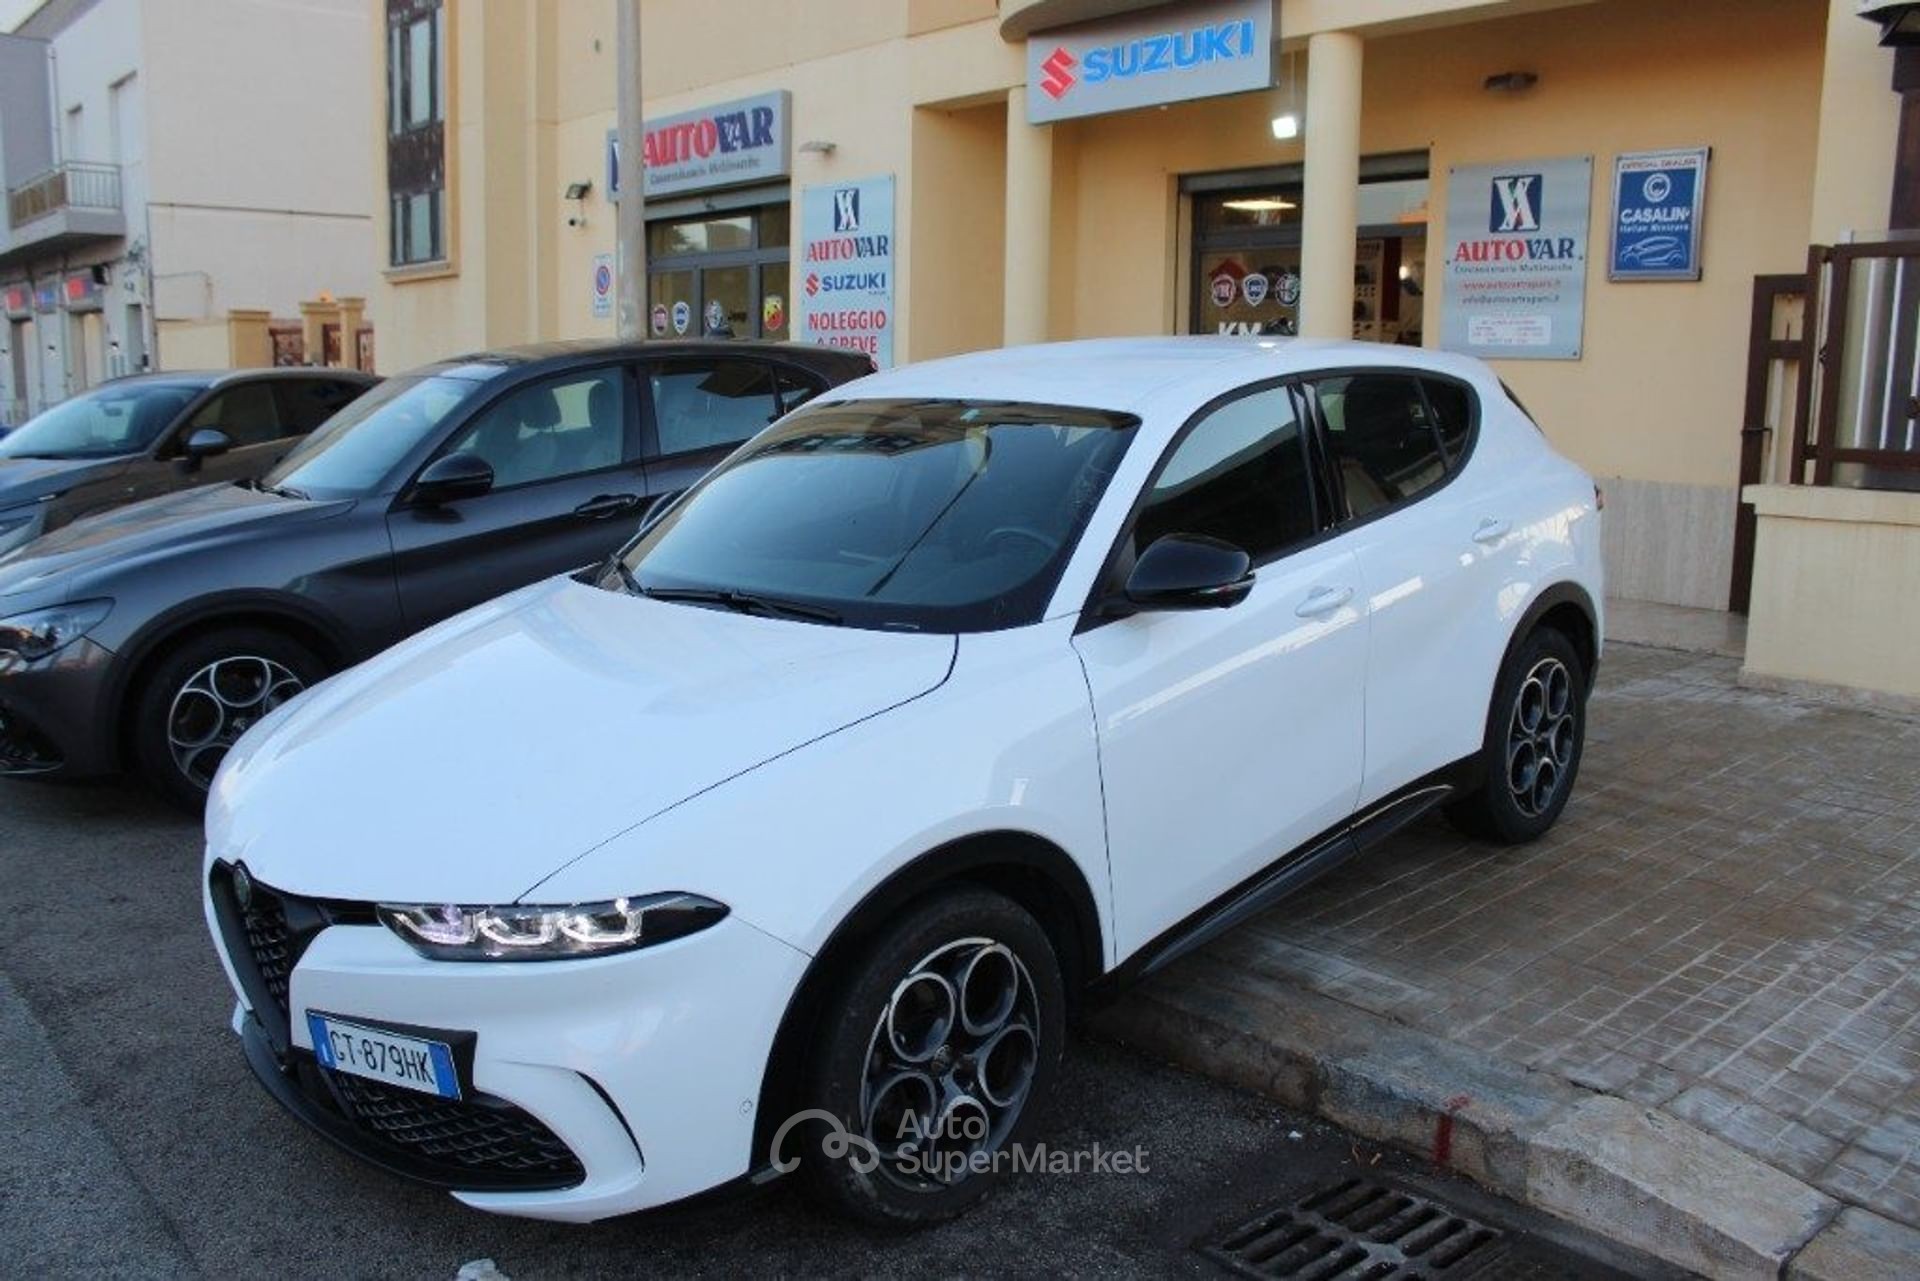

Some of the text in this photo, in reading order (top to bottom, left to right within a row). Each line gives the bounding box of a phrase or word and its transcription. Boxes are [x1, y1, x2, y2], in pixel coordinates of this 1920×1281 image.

[1083, 20, 1255, 84] SUZUKI
[643, 106, 774, 168] AUTOVAR
[806, 235, 888, 262] AUTOVAR
[1455, 237, 1575, 262] AUTOVAR
[822, 273, 886, 292] SUZUKI
[809, 310, 887, 331] NOLEGGIO
